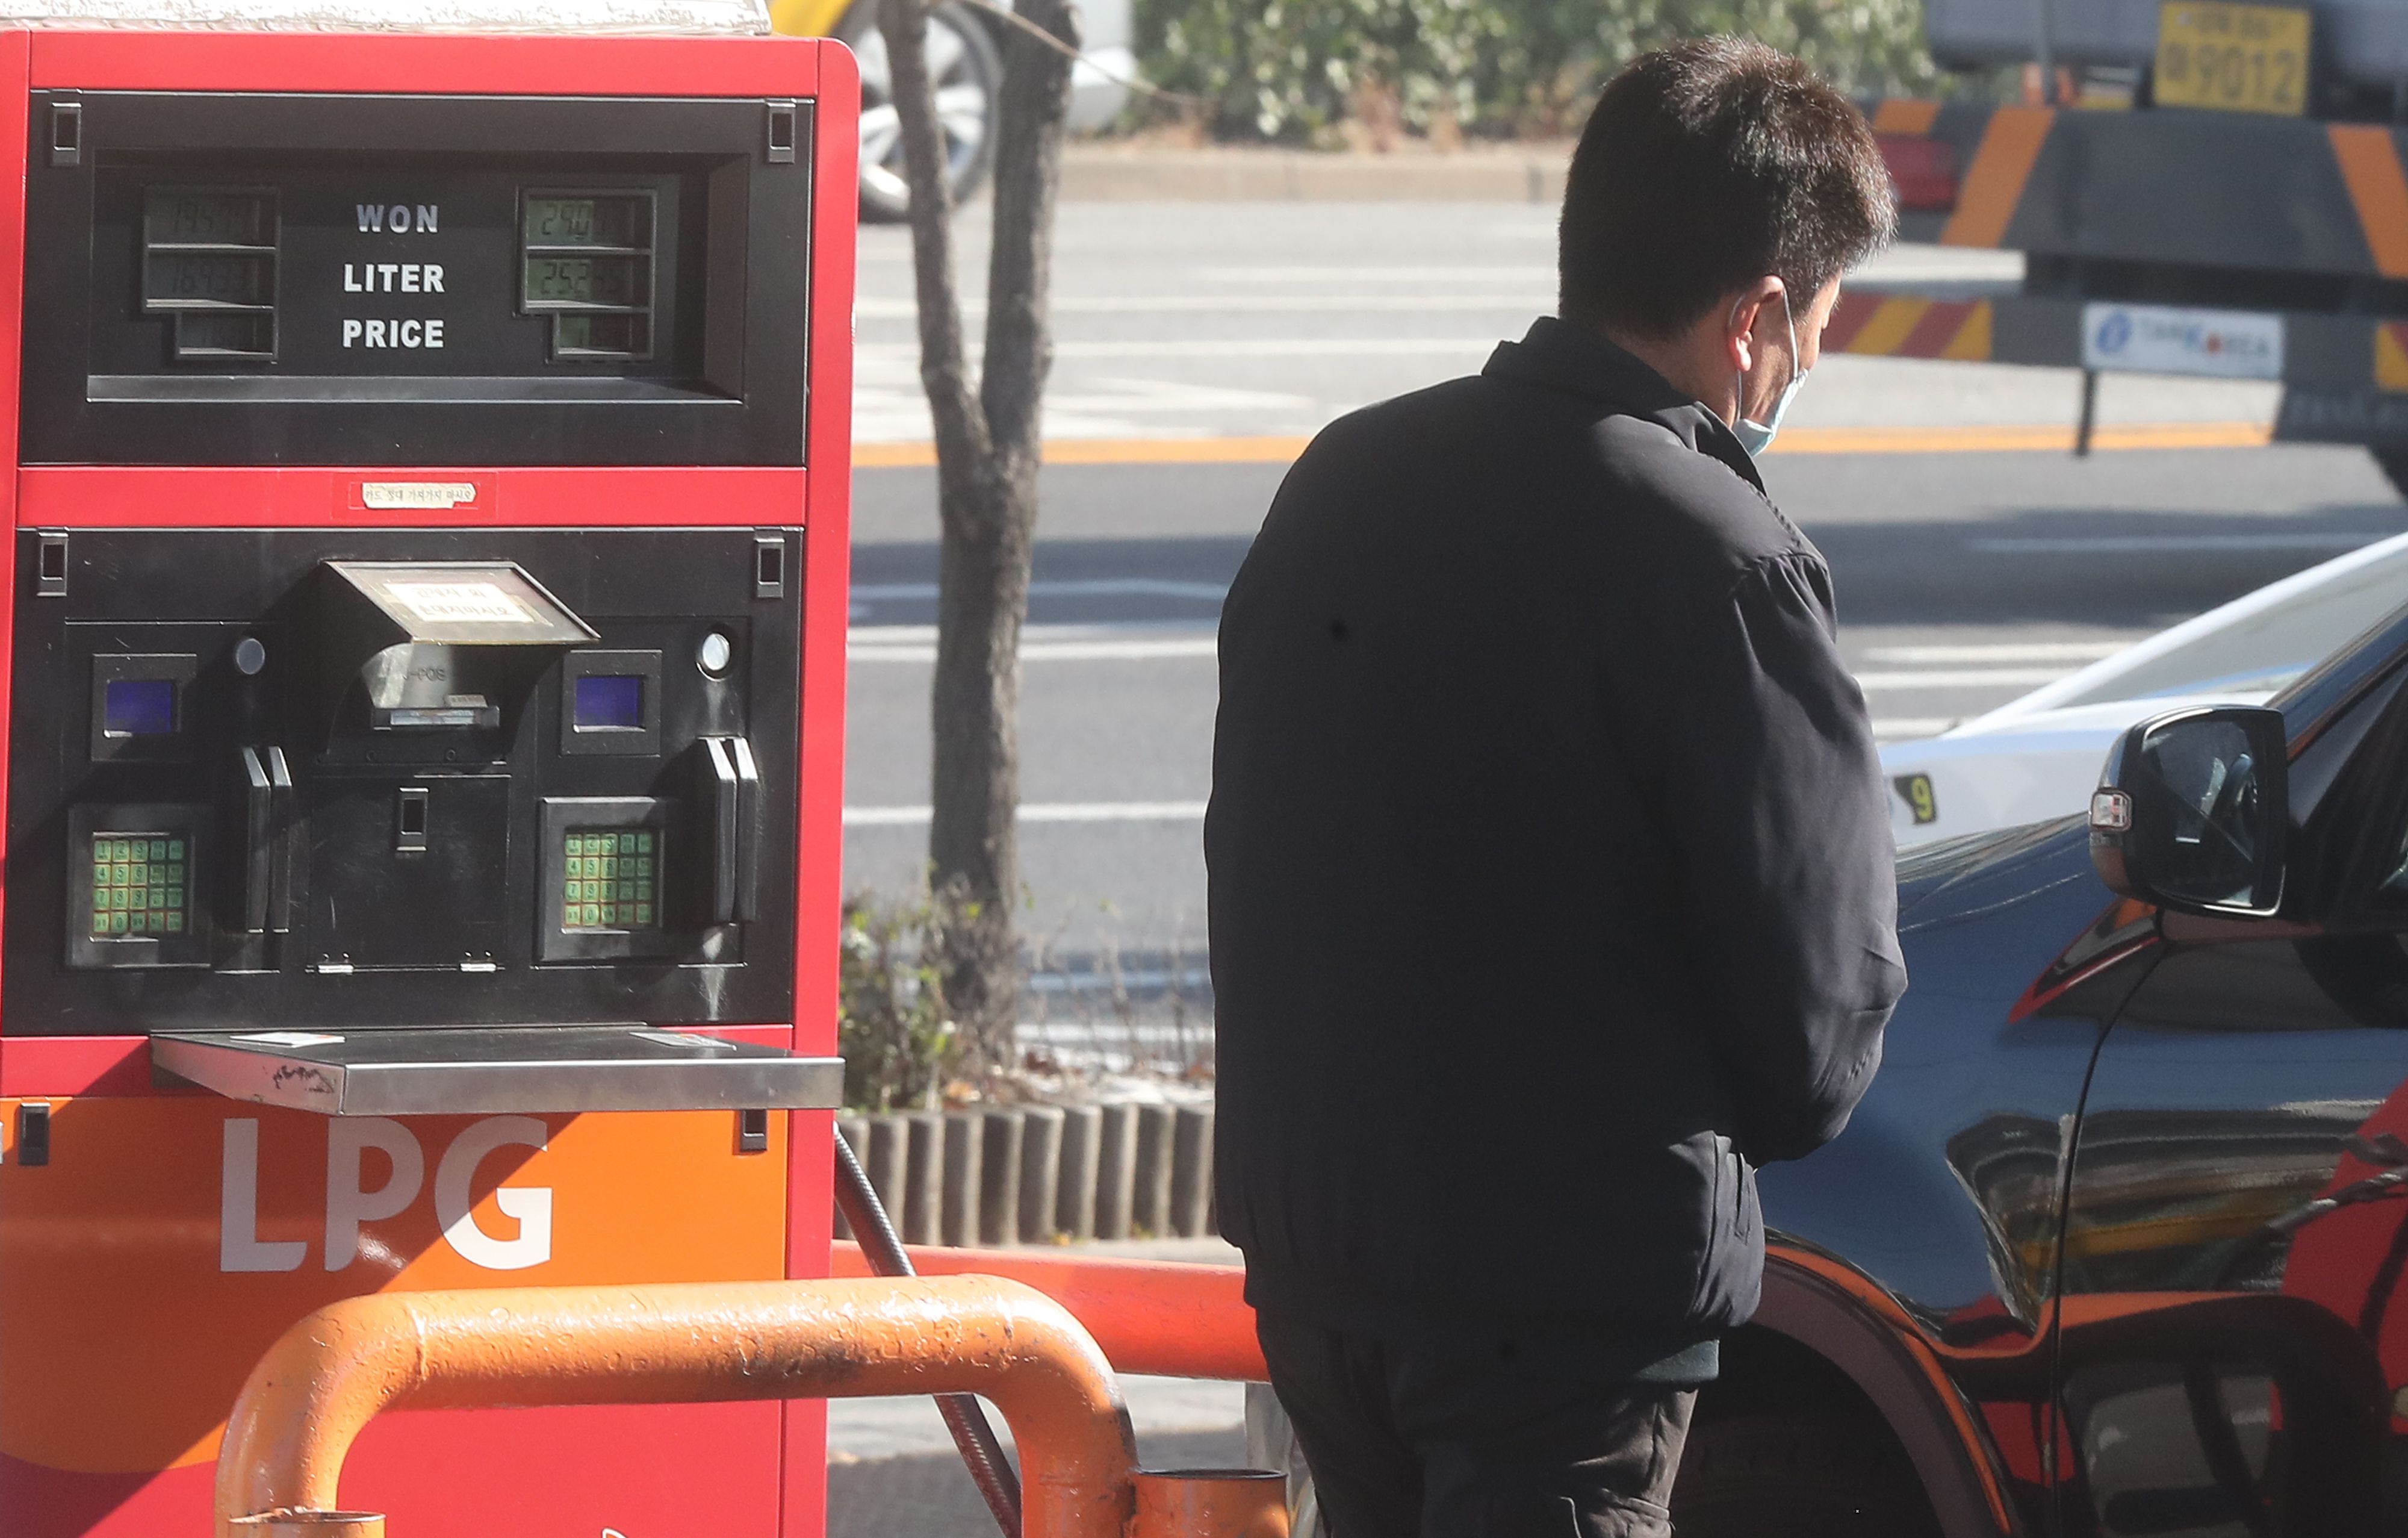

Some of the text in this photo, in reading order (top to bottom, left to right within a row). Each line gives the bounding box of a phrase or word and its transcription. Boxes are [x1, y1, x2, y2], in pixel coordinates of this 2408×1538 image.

[356, 205, 438, 233] WON
[344, 264, 445, 293] LITER
[343, 320, 444, 348] PRICE
[1911, 776, 1932, 821] 9
[220, 1115, 552, 1271] LPG
